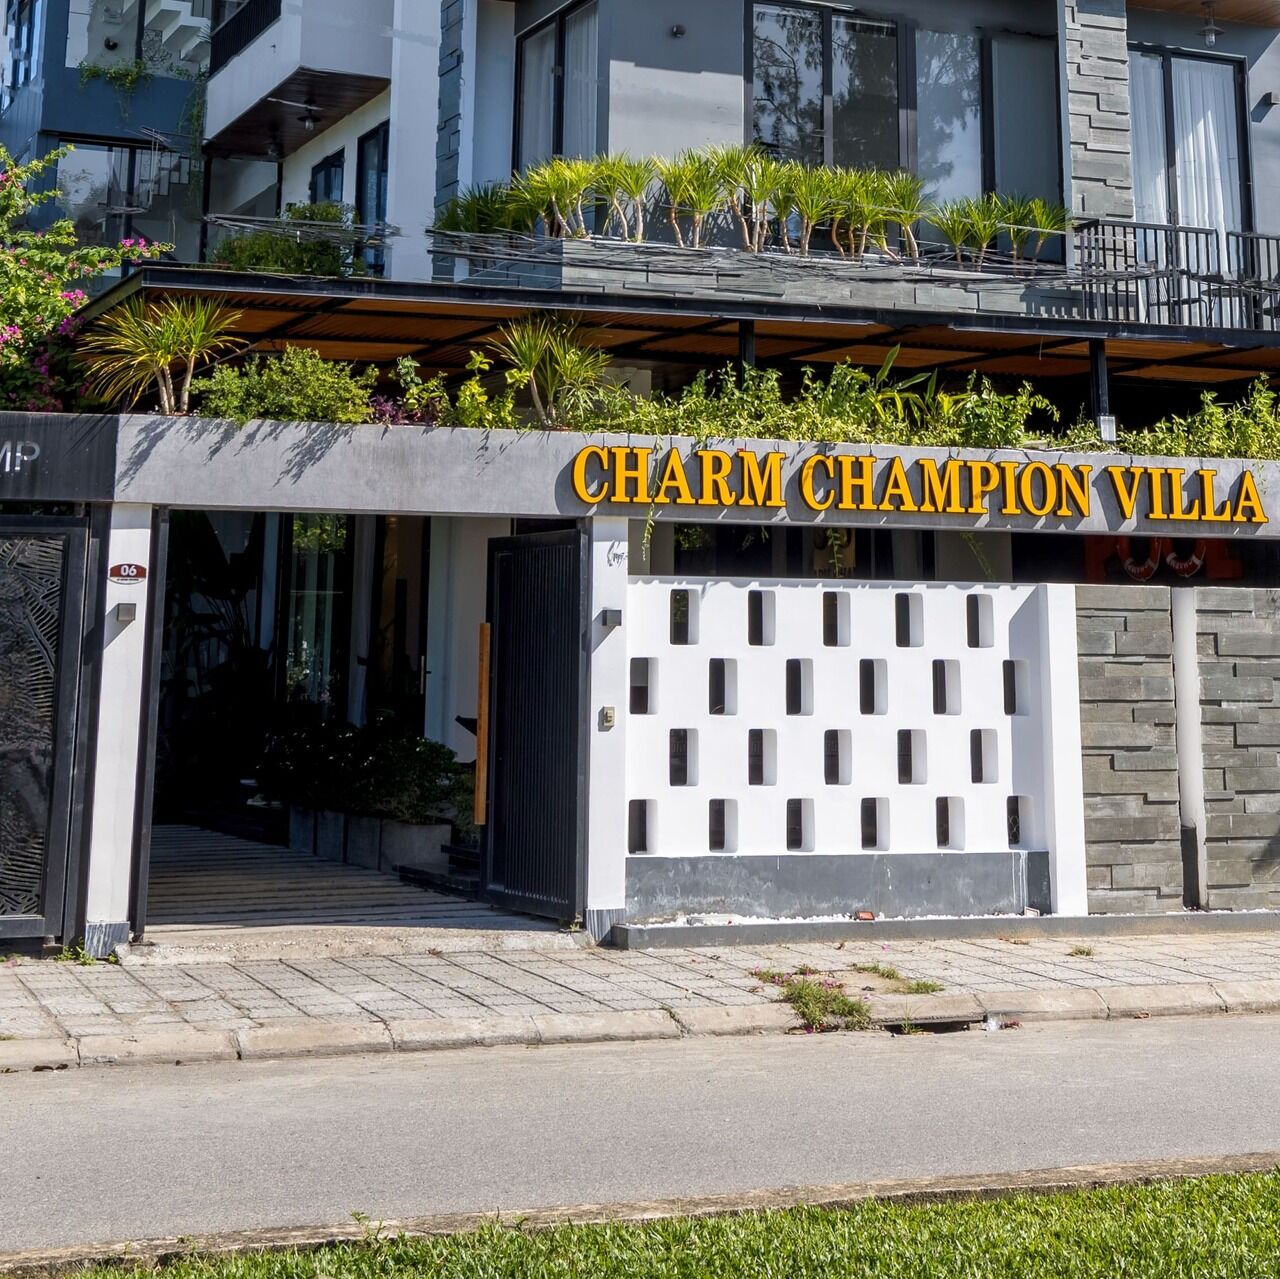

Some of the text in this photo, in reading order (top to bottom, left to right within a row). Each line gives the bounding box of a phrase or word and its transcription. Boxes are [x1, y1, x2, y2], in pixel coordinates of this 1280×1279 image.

[571, 445, 1269, 523] CHARM CHAMPION VILLA
[120, 564, 137, 576] 06
